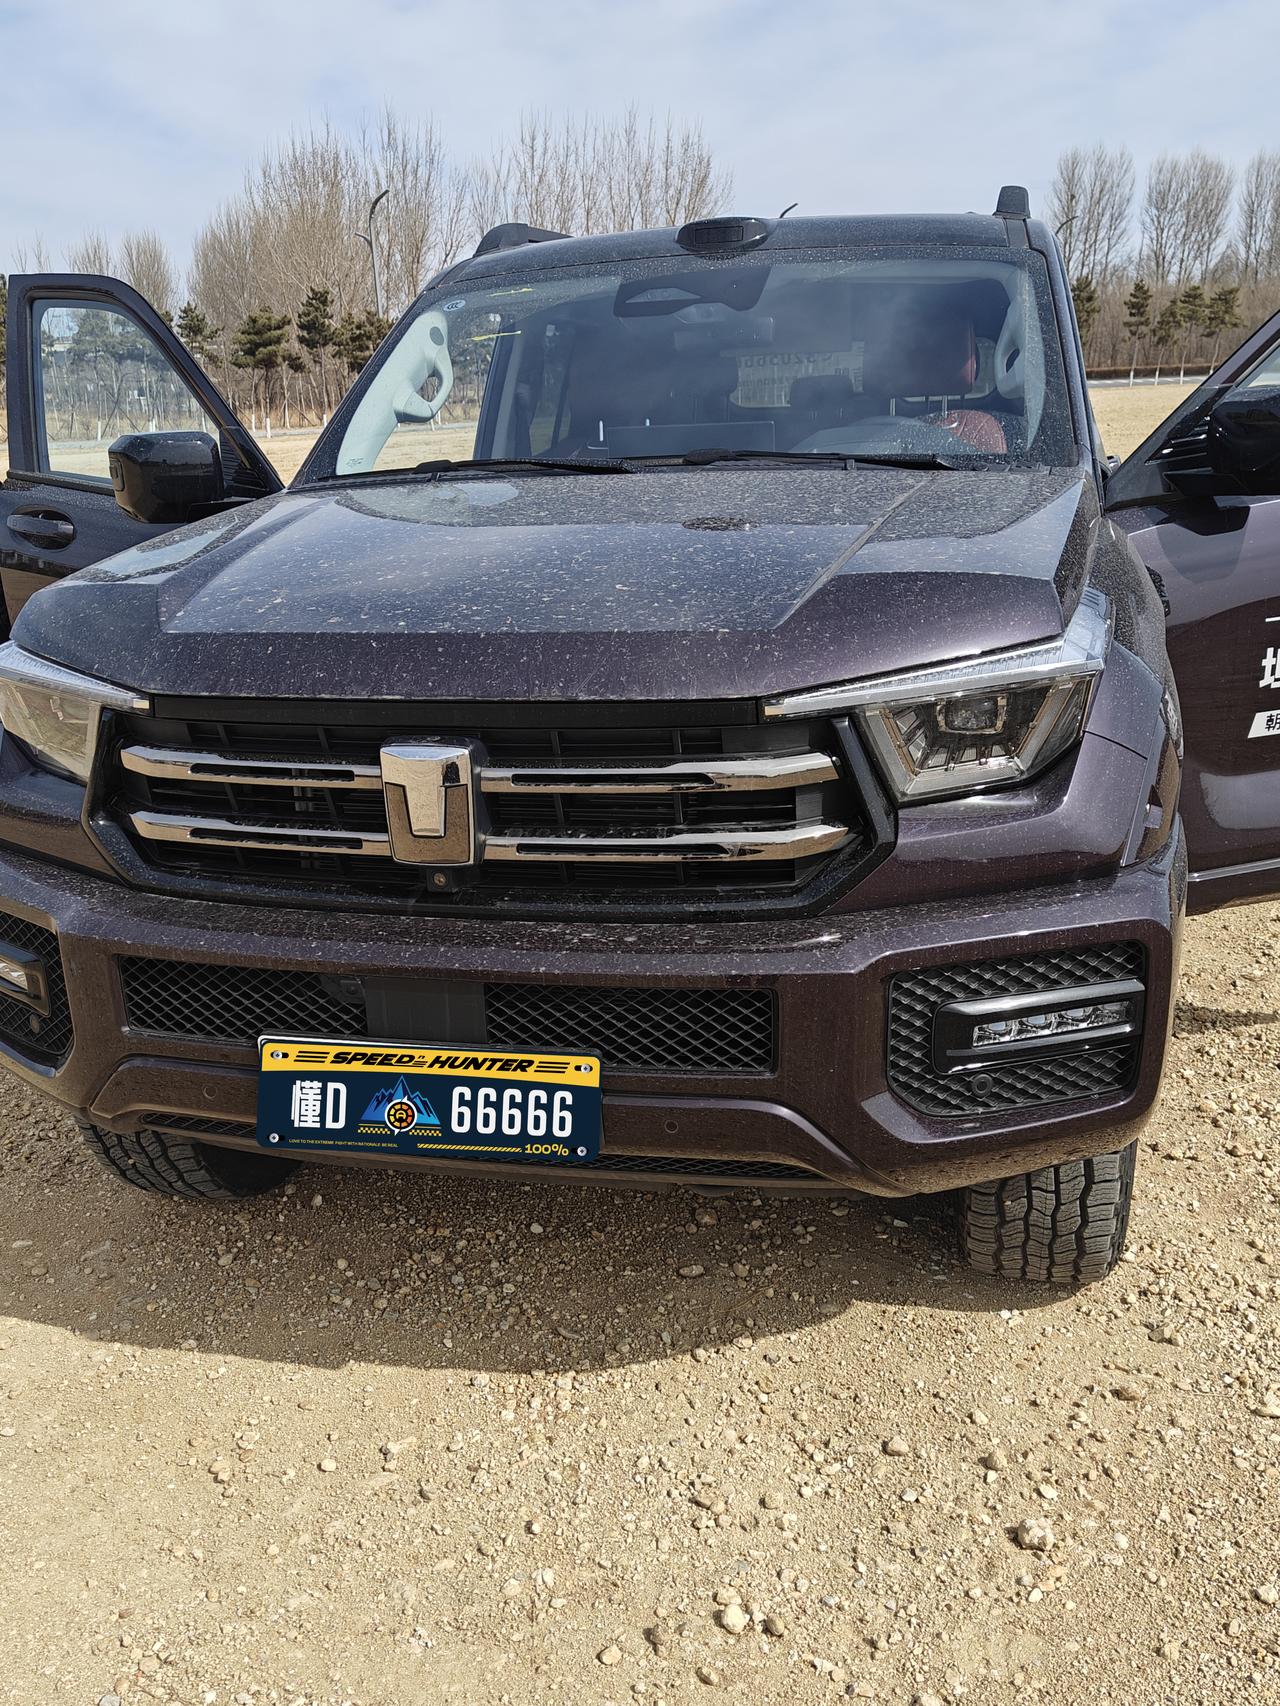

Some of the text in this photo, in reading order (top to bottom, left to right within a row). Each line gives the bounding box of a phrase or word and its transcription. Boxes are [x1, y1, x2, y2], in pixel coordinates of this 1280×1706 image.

[330, 1051, 416, 1066] SPEED
[427, 1055, 535, 1073] HUNTER
[451, 1086, 573, 1138] 66666
[524, 1142, 569, 1156] 100%
